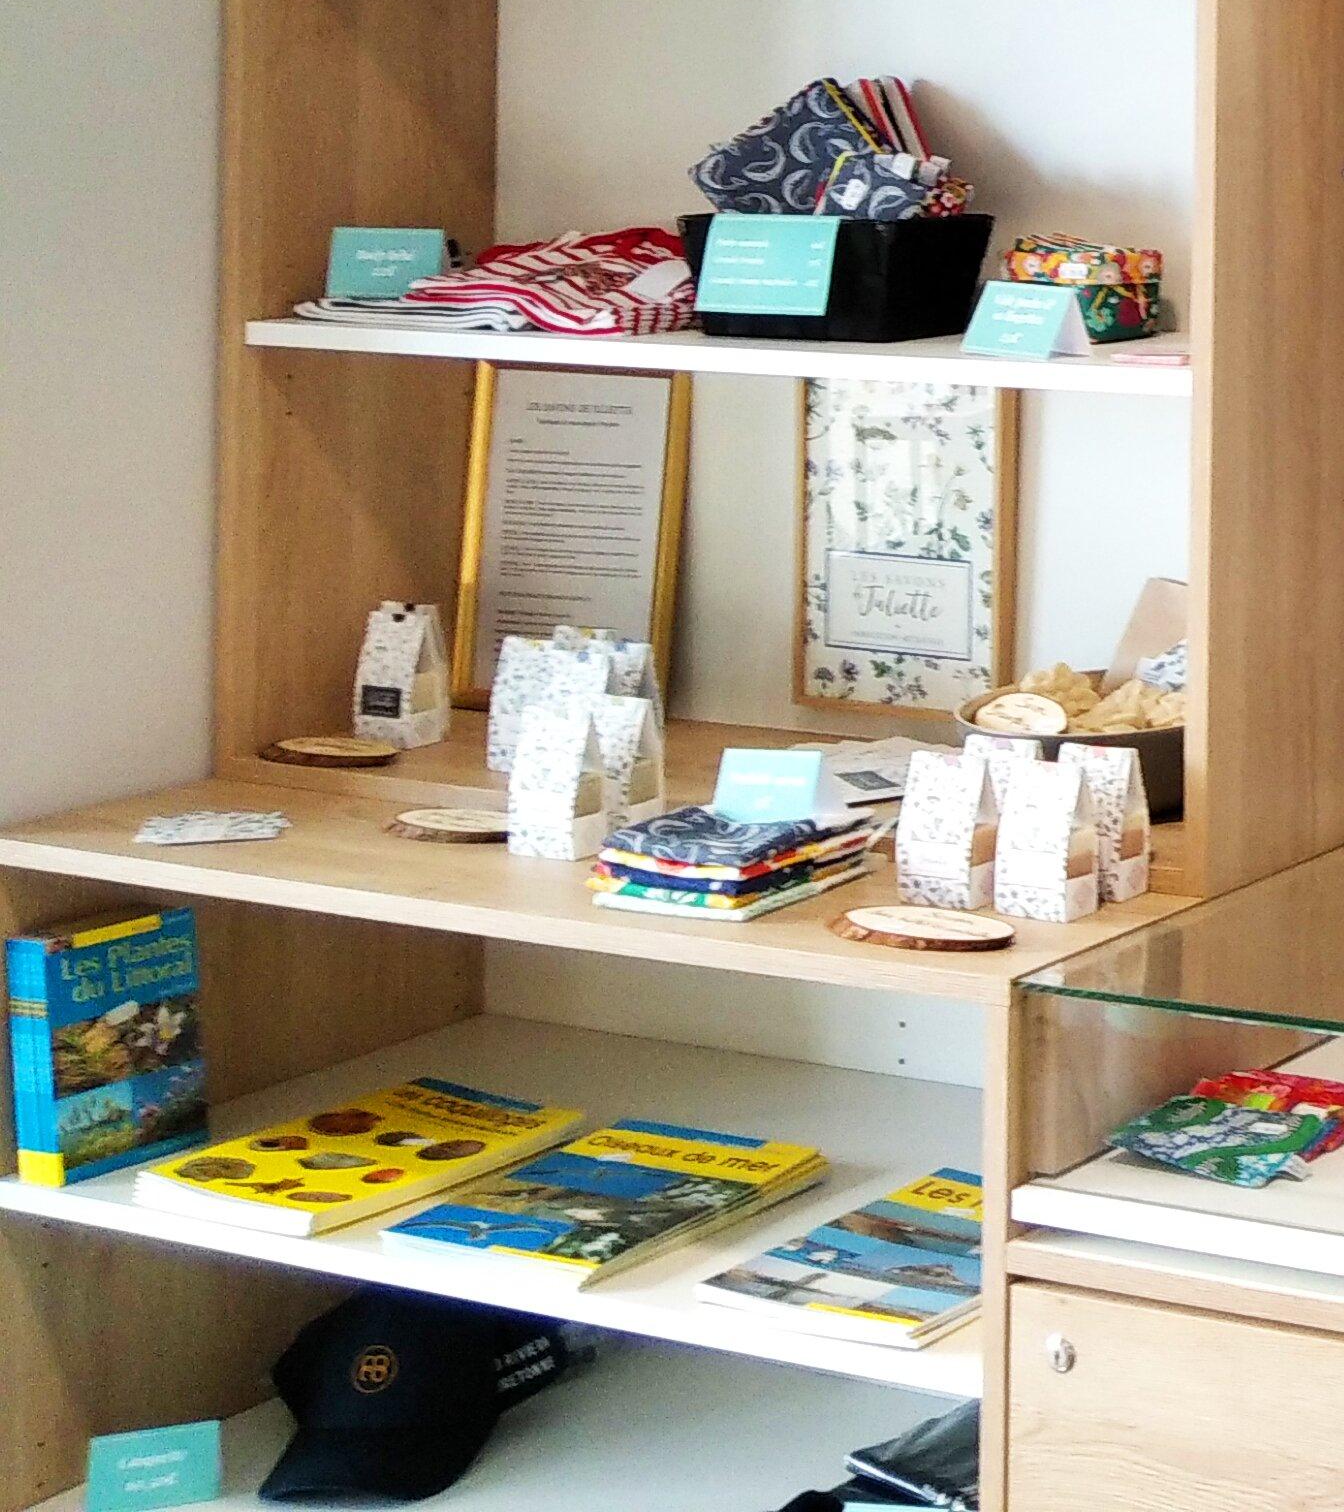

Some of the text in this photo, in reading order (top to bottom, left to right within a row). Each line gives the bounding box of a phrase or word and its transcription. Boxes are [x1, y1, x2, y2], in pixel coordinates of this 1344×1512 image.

[682, 1150, 716, 1165] de
[722, 1154, 782, 1174] mer
[911, 1180, 952, 1203] Les
